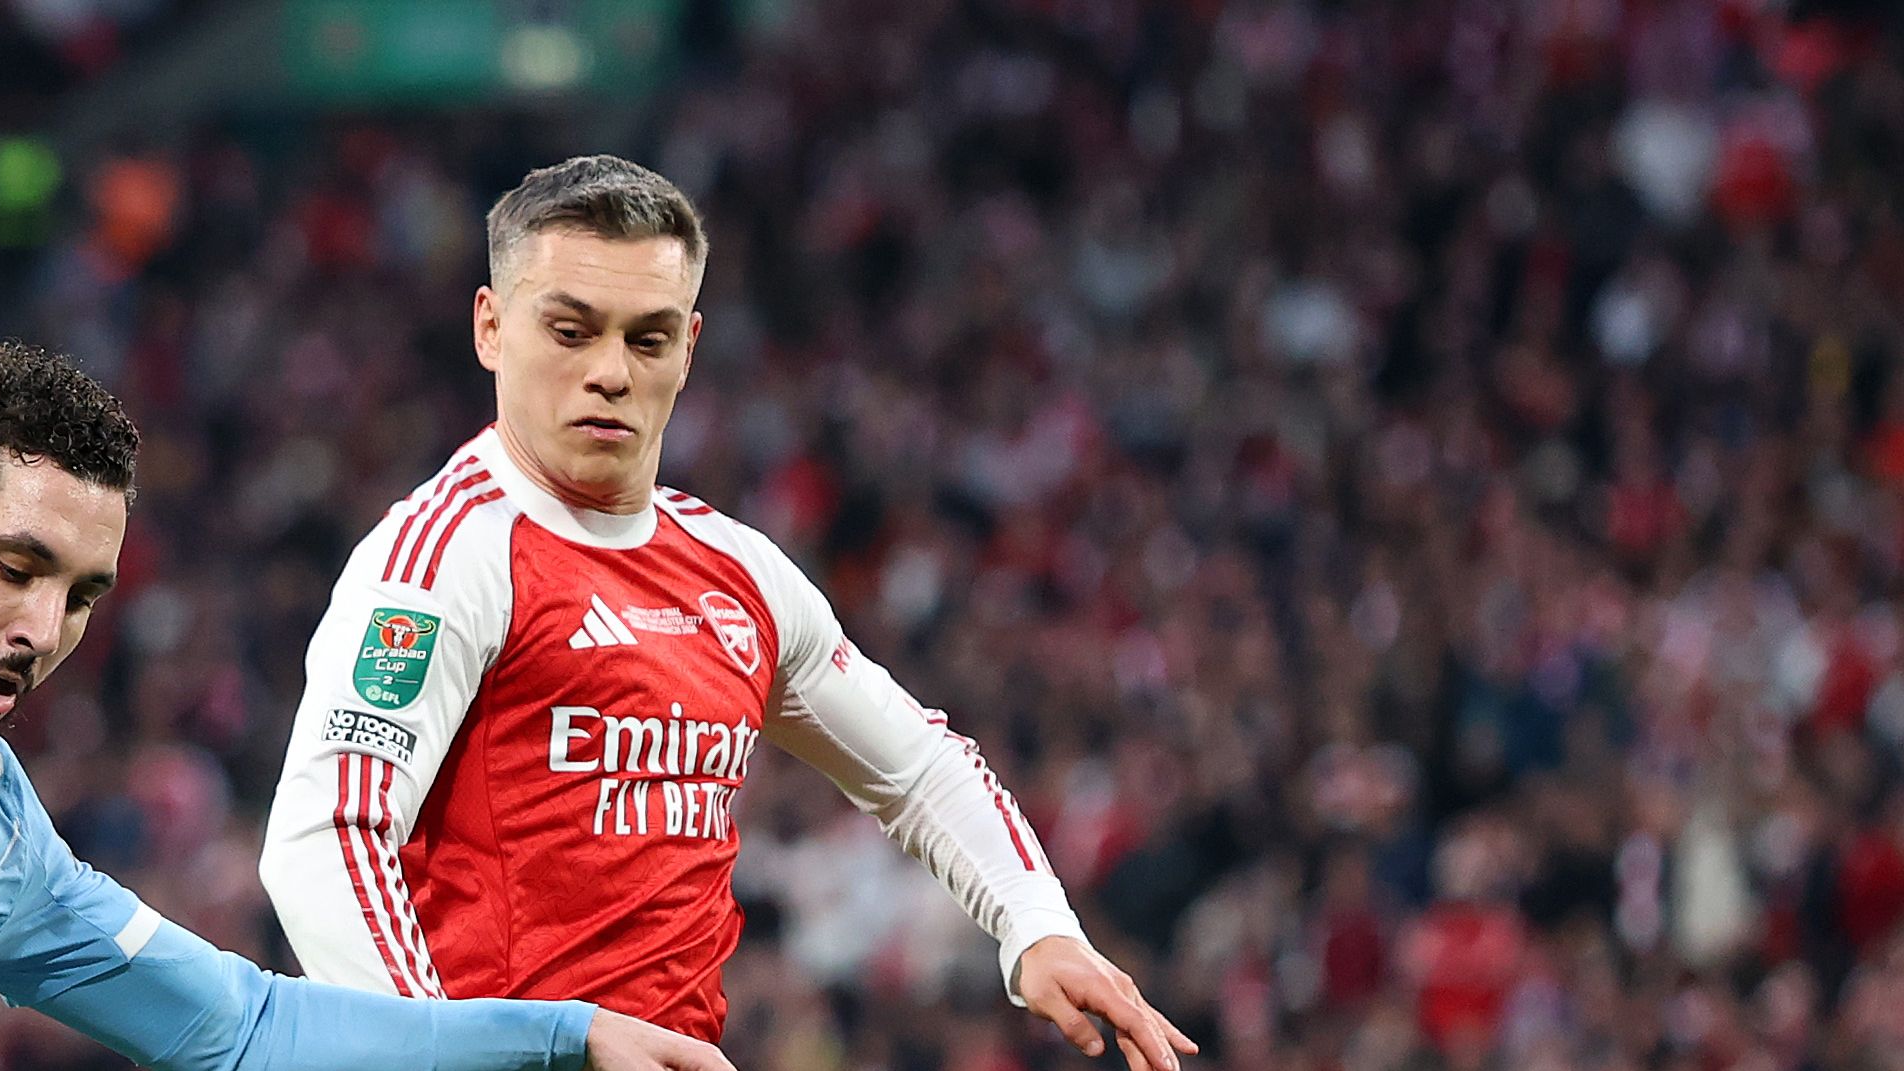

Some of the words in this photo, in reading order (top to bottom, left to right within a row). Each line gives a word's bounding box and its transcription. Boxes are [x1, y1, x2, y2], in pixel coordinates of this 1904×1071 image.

[362, 646, 427, 660] Carabao
[375, 659, 406, 673] Cup
[382, 690, 400, 705] EFL
[329, 709, 356, 727] No
[357, 715, 409, 748] room
[549, 702, 760, 780] Emirat
[352, 730, 412, 764] racism
[593, 778, 649, 835] FLY
[662, 780, 736, 842] BETT
